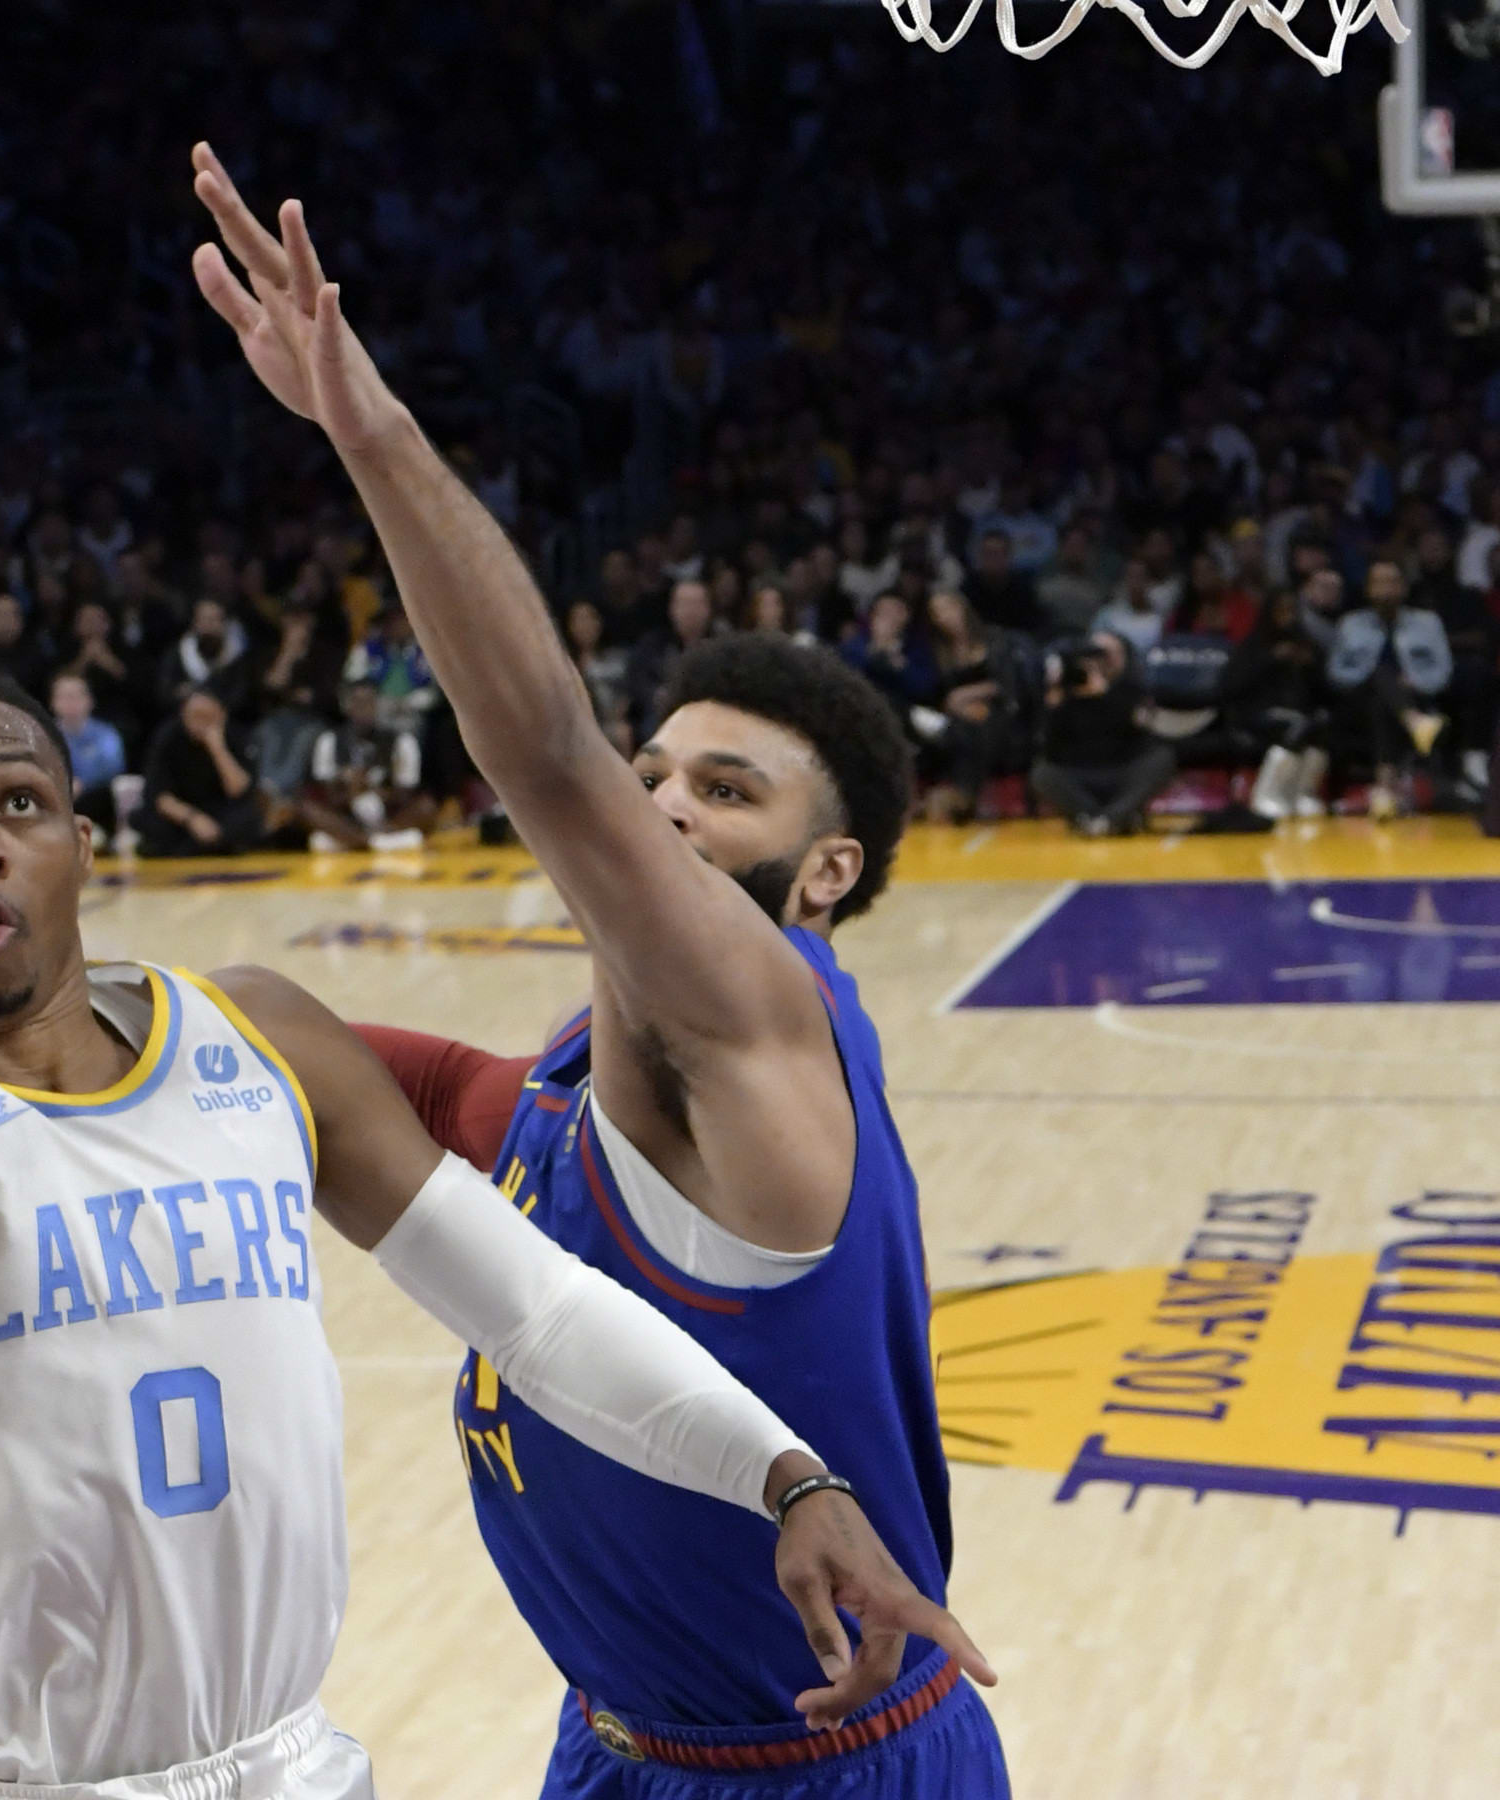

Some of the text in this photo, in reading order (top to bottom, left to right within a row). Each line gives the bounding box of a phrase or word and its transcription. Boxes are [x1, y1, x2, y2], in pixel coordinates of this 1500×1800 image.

[192, 1085, 274, 1113] bibigo
[1101, 1343, 1252, 1422] LOS
[130, 1366, 232, 1520] 0
